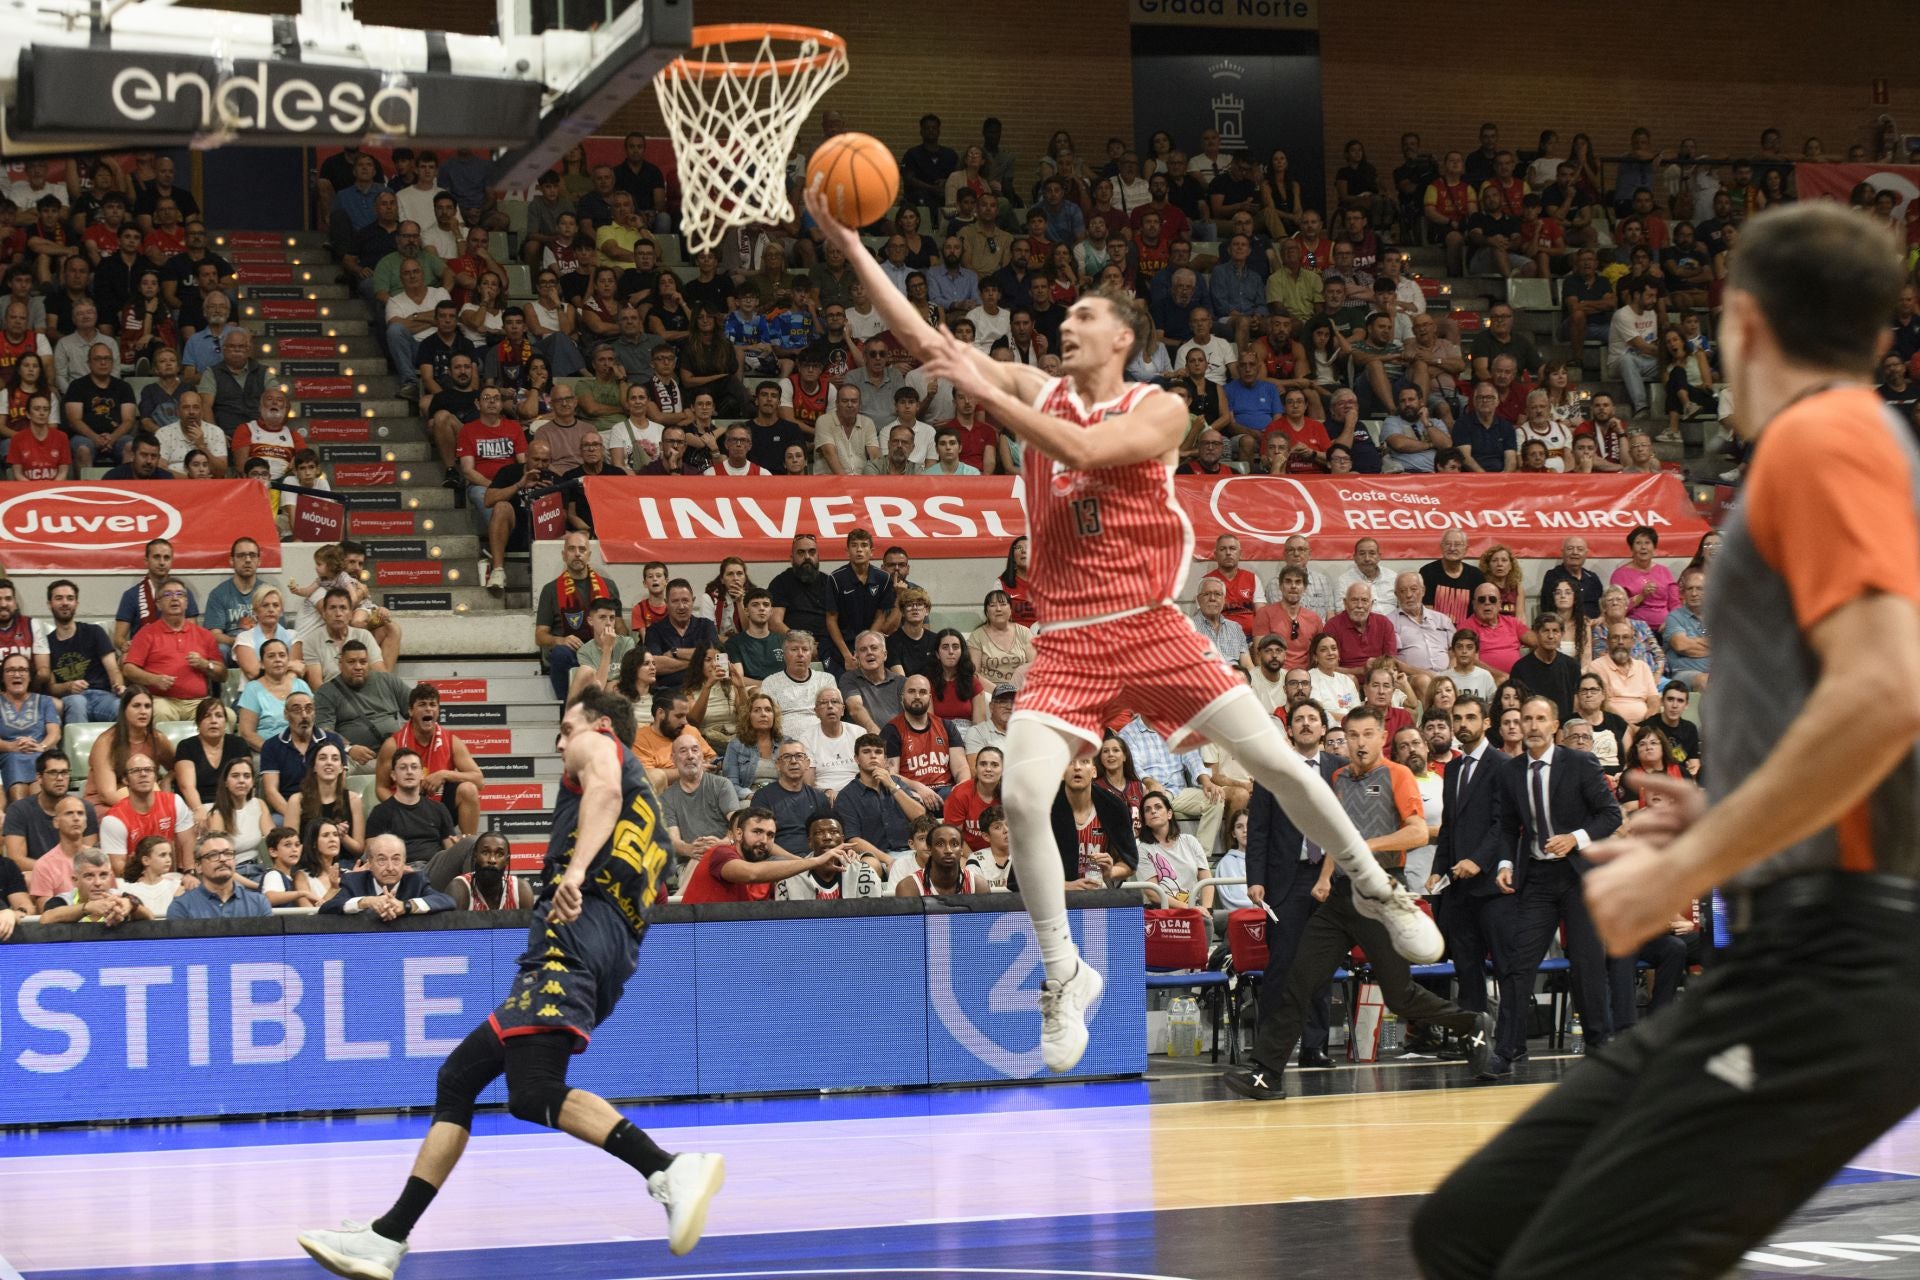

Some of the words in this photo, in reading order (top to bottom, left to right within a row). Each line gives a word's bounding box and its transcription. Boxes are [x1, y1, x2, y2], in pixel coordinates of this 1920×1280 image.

[112, 61, 420, 137] endesa
[476, 440, 515, 456] FINALS
[1338, 488, 1388, 504] Costa
[1390, 489, 1441, 506] Cálida
[14, 509, 158, 534] Juver
[301, 511, 337, 528] MÓDULO
[537, 508, 561, 524] MÓDULO
[1071, 498, 1102, 536] 13
[1344, 506, 1477, 531] REGIÓN
[1479, 509, 1525, 529] DE
[1535, 508, 1671, 530] MURCIA
[315, 527, 321, 536] 7
[906, 750, 950, 772] UCAM
[914, 765, 947, 777] MURCIA
[1159, 919, 1191, 930] UCAM
[0, 956, 470, 1074] STIBLE
